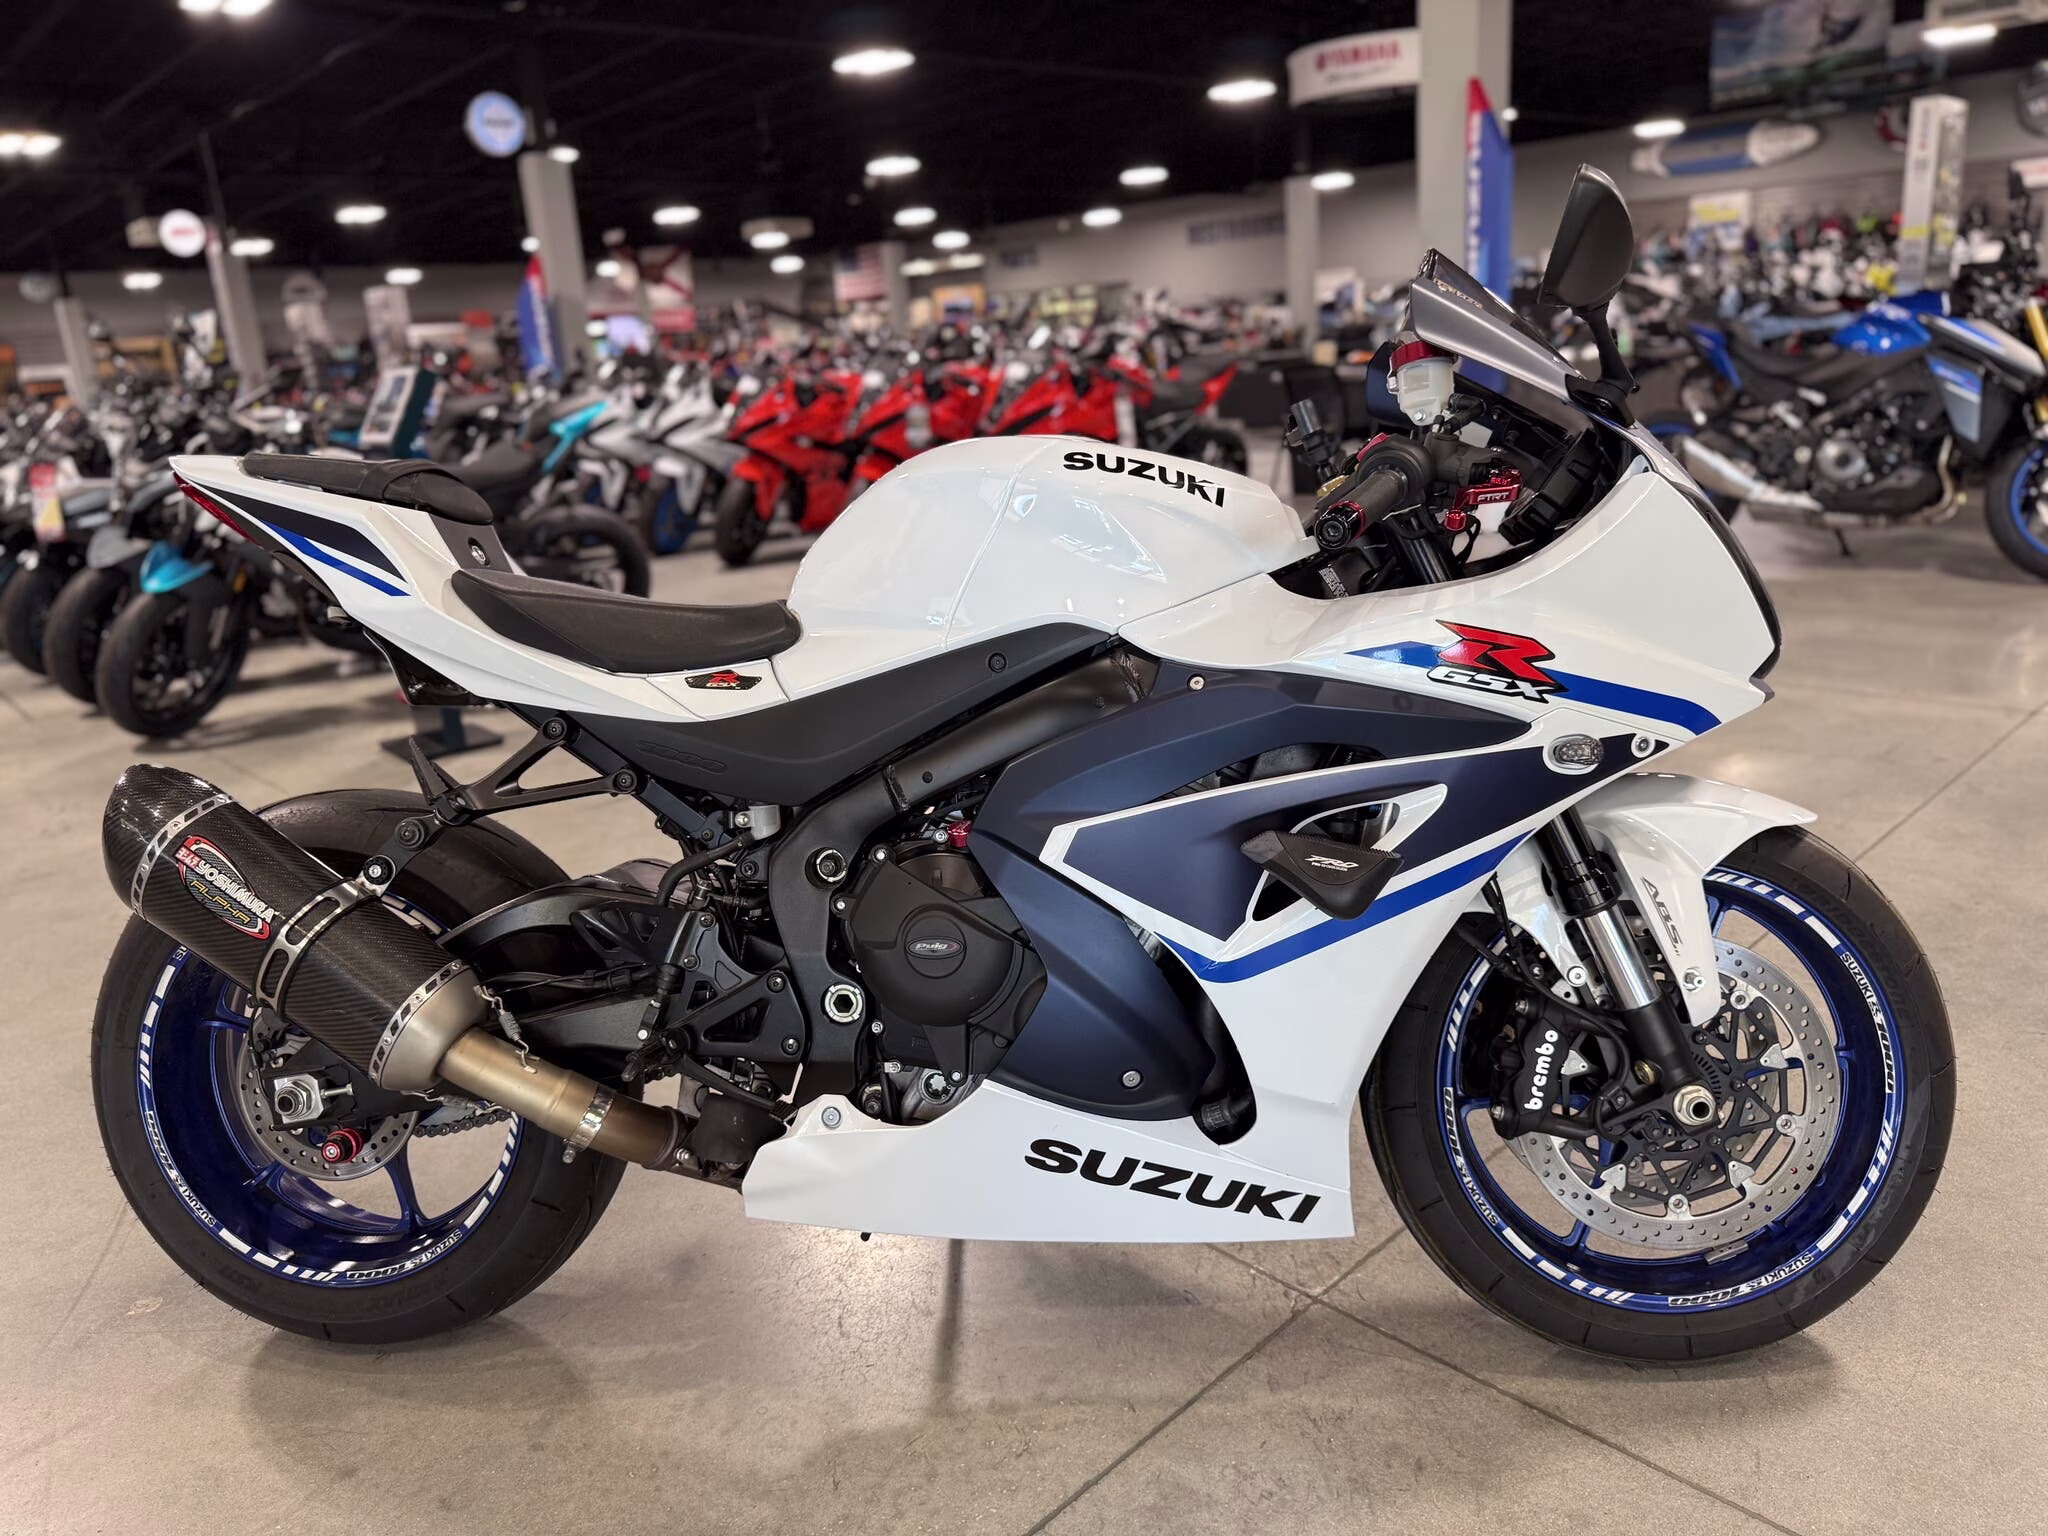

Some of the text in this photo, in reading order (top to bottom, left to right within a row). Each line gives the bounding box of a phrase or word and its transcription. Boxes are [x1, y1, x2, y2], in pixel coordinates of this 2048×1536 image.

[1063, 452, 1225, 508] SUZUKI
[1436, 620, 1560, 686] R
[1427, 665, 1556, 701] GSX
[190, 880, 251, 924] ALPHA
[194, 859, 275, 924] YOSHIMURA
[1640, 876, 1683, 948] ABS
[1842, 951, 1875, 1000] SUZUKI
[1524, 1030, 1558, 1110] brembo
[1024, 1138, 1321, 1223] SUZUKI
[1464, 1176, 1498, 1227] SUZUKI
[181, 1186, 217, 1227] SUZUKI
[424, 1228, 463, 1260] SUZUKI
[1763, 1252, 1814, 1283] SUZUKI
[1668, 1284, 1746, 1307] 1000
